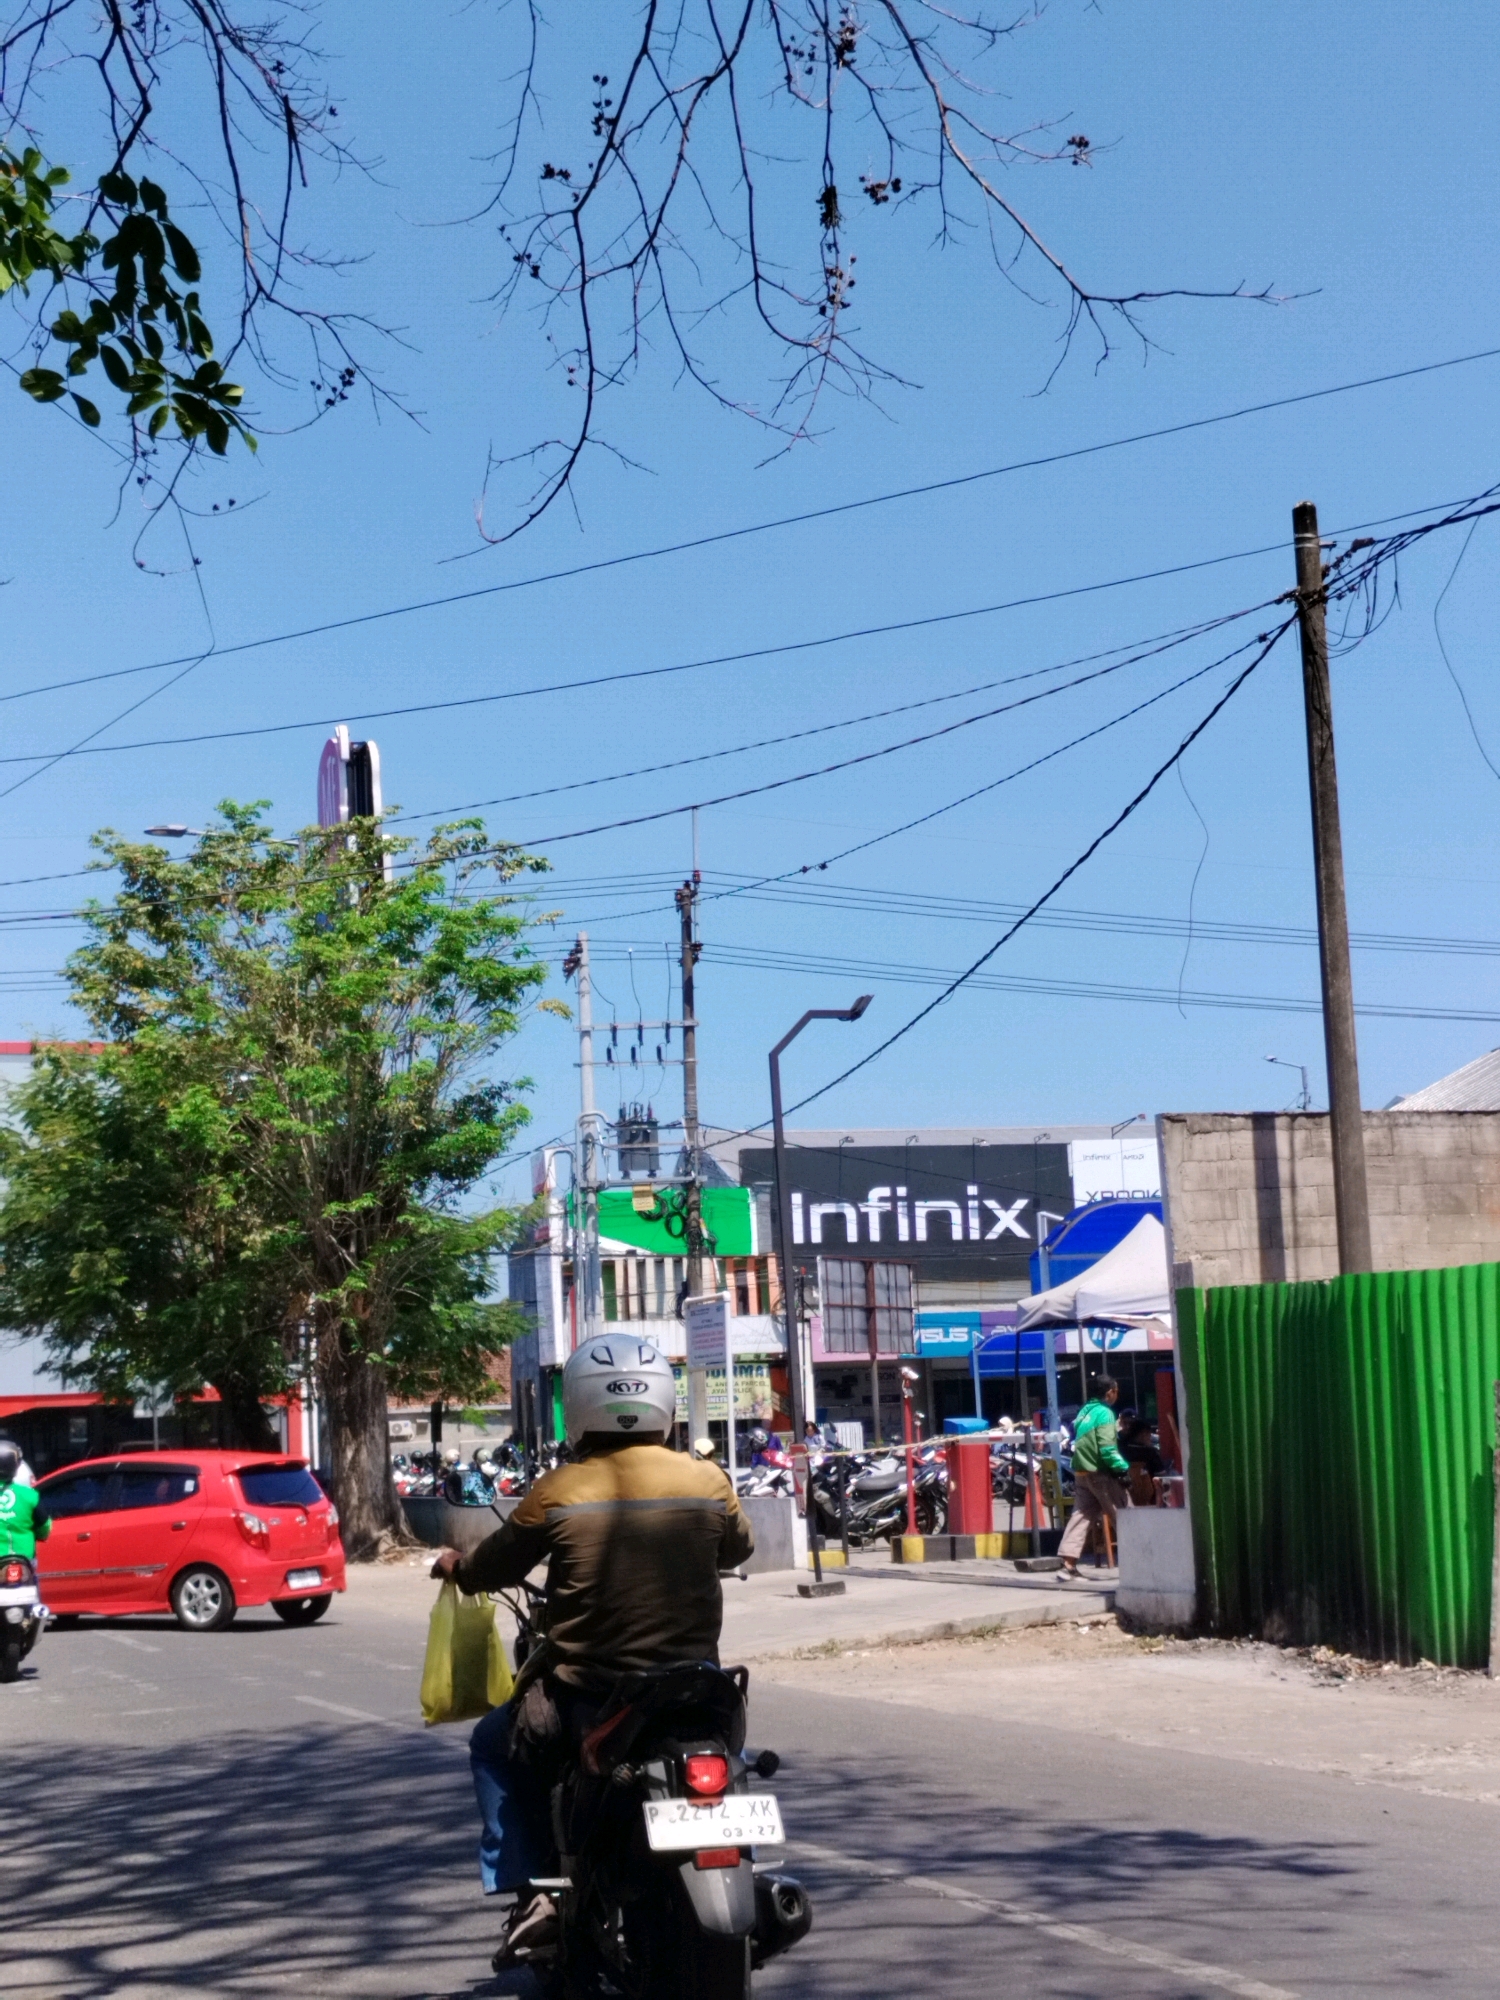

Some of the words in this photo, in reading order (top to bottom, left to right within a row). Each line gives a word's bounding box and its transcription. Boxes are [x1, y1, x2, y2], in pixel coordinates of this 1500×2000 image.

[791, 1185, 1031, 1244] Infinix
[610, 1382, 645, 1393] KYT
[648, 1806, 659, 1824] P
[748, 1800, 773, 1818] XK
